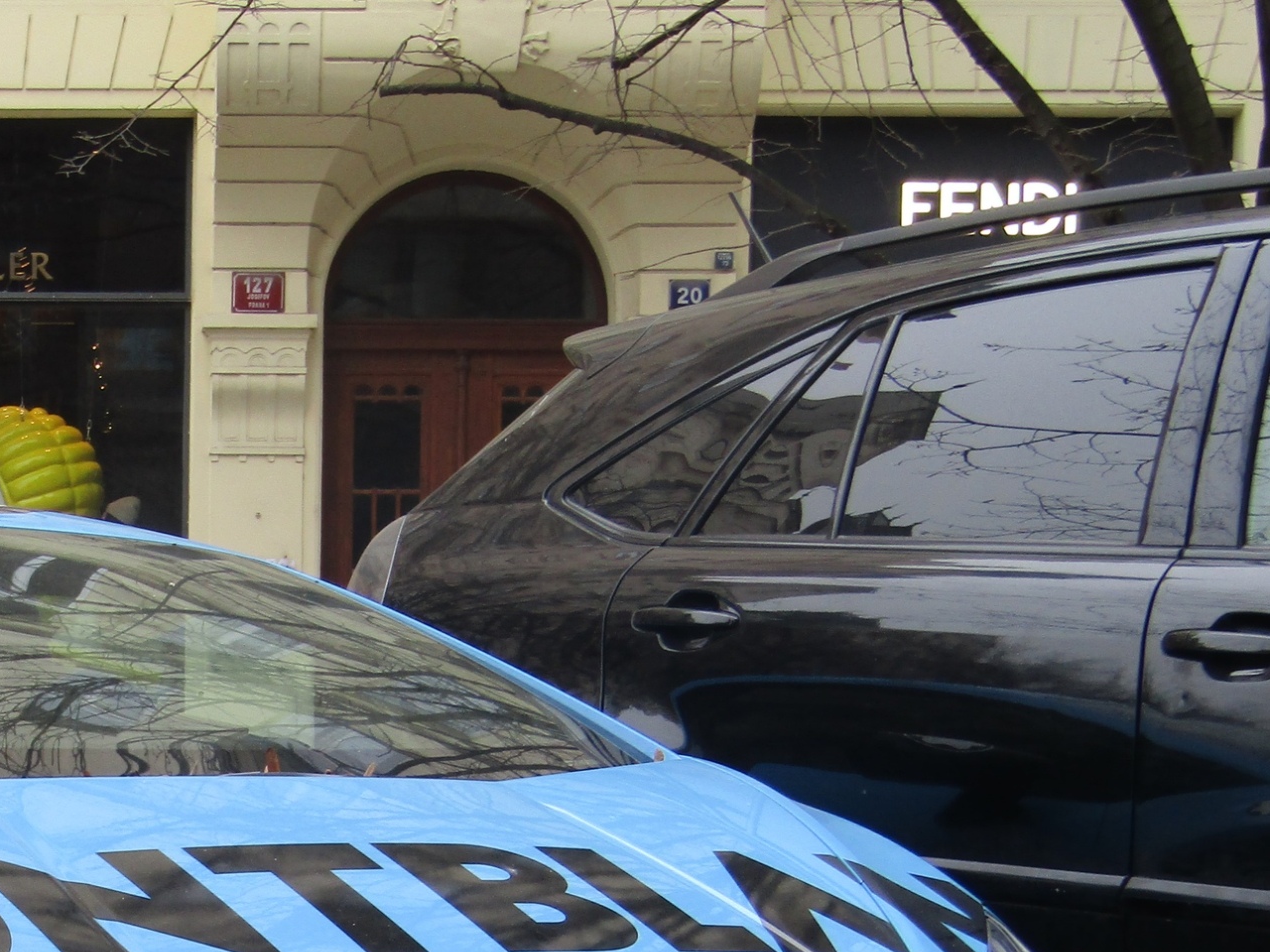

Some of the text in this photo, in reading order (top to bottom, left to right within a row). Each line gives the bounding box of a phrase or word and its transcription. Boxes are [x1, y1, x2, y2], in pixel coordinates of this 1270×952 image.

[900, 181, 1078, 236] FENDI
[244, 276, 274, 294] 127
[676, 287, 703, 305] 20
